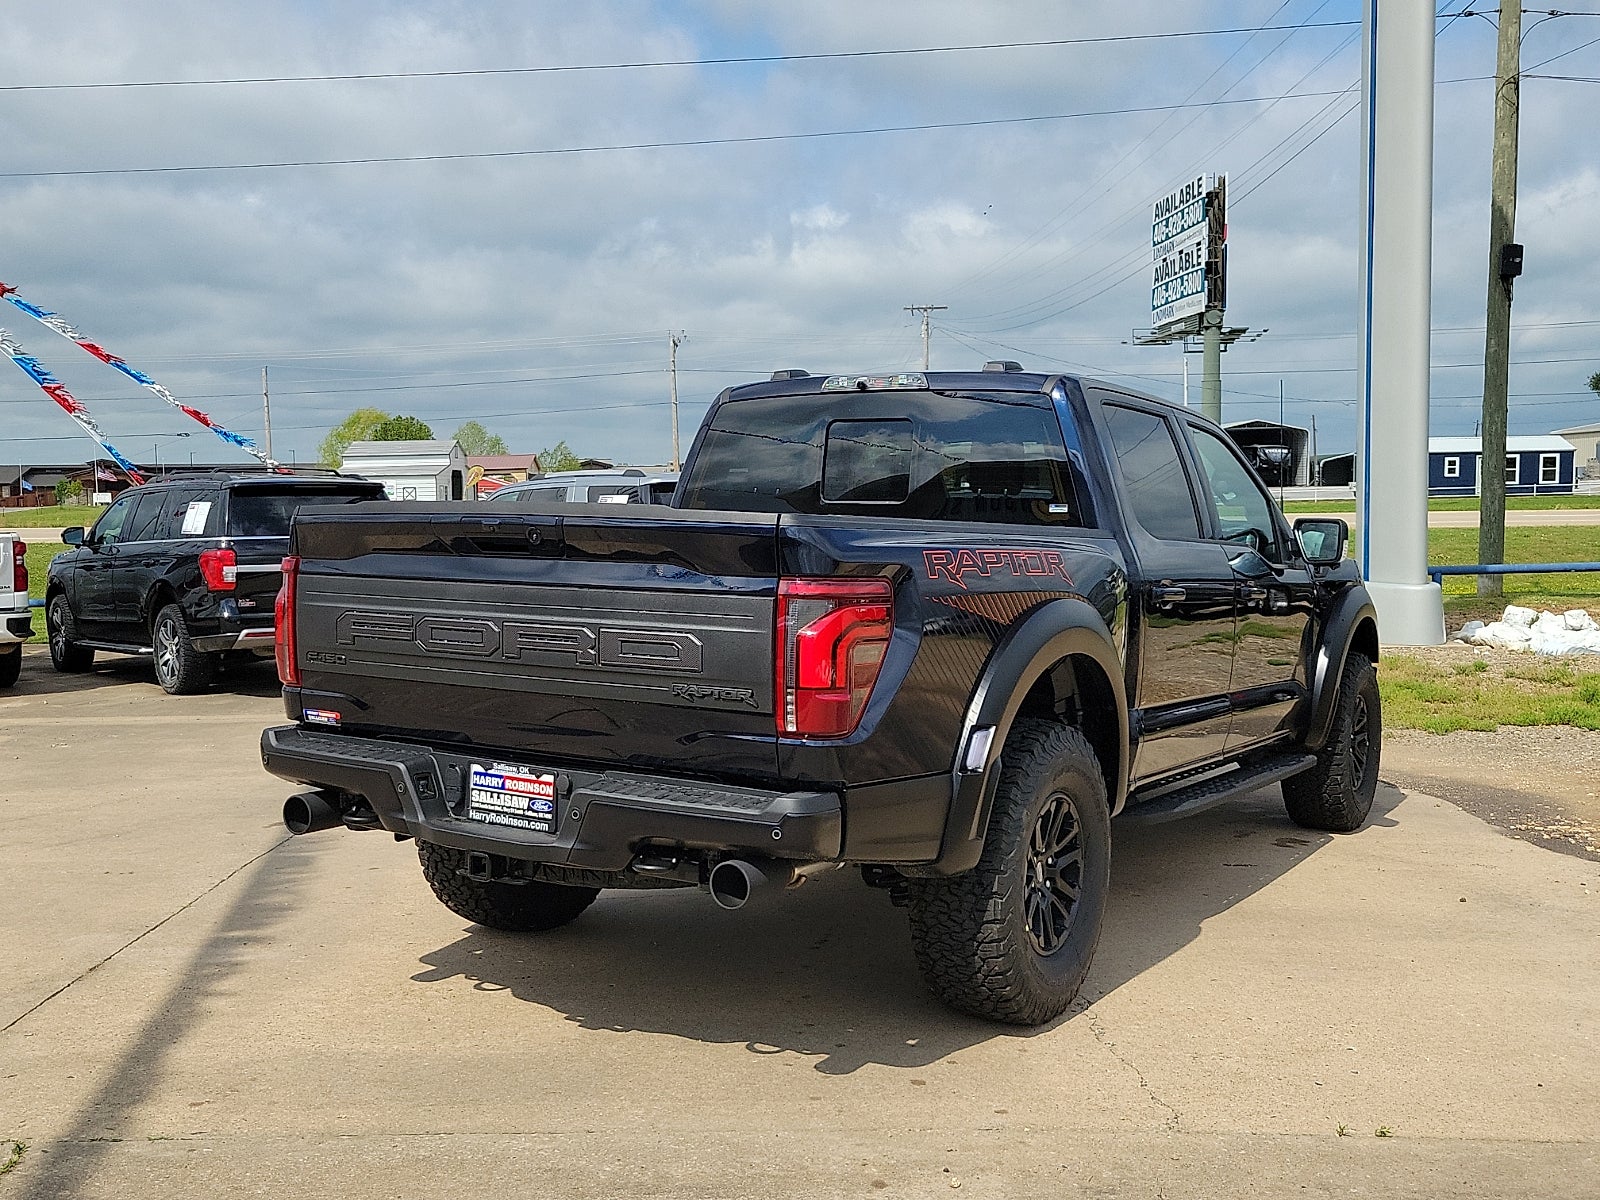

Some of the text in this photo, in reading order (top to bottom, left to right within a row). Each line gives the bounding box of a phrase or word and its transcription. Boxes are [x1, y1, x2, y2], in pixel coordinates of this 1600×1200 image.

[1153, 175, 1203, 222] AVAILABLE
[1153, 199, 1203, 245] 405-928-5800
[1153, 246, 1202, 286] AVAILABLE
[1153, 270, 1202, 309] 405-928-5800
[922, 549, 1076, 591] RAPTOR
[335, 610, 704, 674] FORD
[671, 682, 760, 710] RAPTOR
[473, 774, 505, 789] HARRY
[505, 779, 554, 797] ROBINSON
[519, 766, 530, 775] OK
[471, 789, 530, 810] SALLISAW
[532, 800, 551, 812] Ford
[469, 809, 549, 832] HarryRobinson.com
